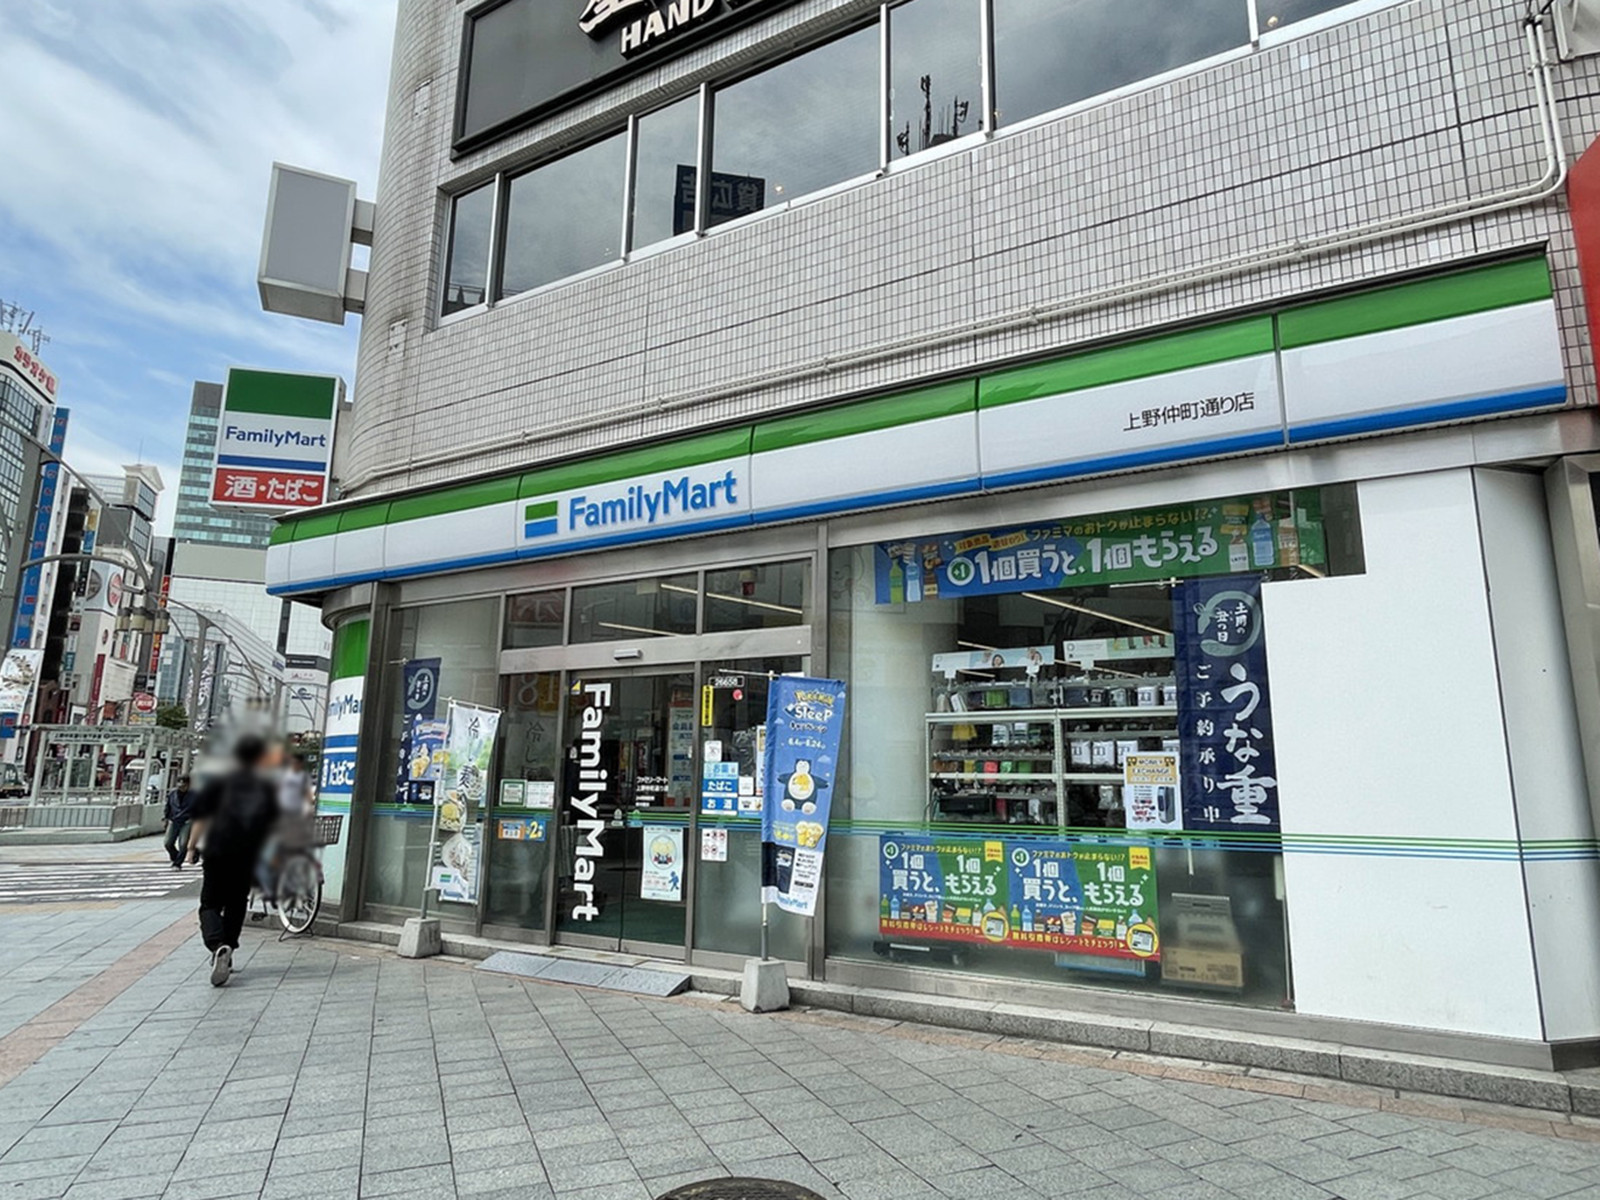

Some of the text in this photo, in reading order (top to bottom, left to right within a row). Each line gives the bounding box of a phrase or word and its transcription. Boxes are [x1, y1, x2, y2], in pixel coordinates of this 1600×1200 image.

[1123, 392, 1255, 431] 上野仲町通り店
[225, 426, 327, 447] FamilyMart
[224, 475, 319, 501] 酒・たばこ
[569, 470, 737, 531] FamilyMart
[1196, 663, 1220, 824] ご予約承り中
[1216, 662, 1277, 825] うな重
[707, 781, 733, 791] たばこ
[570, 683, 612, 922] FamilyMart
[901, 852, 924, 870] 1個
[956, 854, 981, 874] 1個
[1033, 858, 1059, 878] 1個
[1096, 861, 1125, 882] 1個
[945, 873, 997, 896] もらえる
[1083, 882, 1144, 907] もらえる
